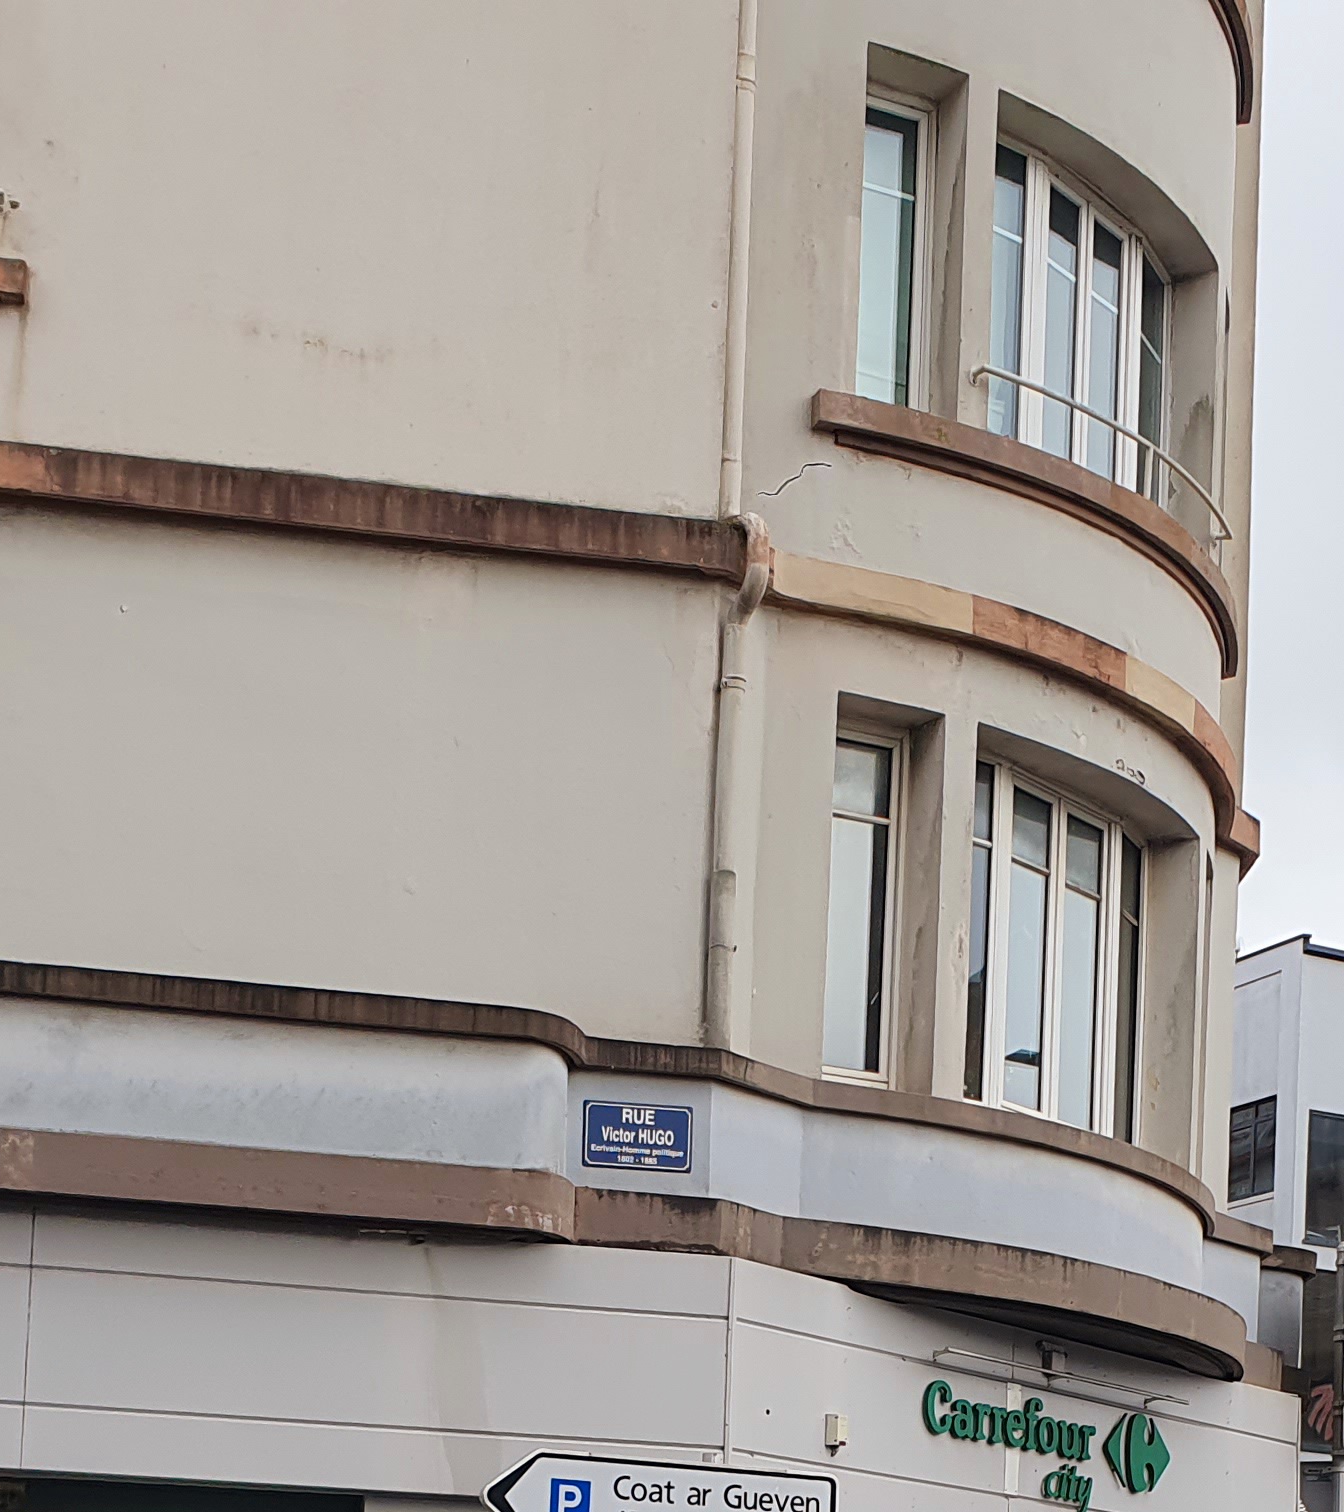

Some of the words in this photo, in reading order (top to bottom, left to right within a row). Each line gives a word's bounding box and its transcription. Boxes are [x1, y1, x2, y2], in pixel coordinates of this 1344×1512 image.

[622, 1108, 656, 1125] RUE
[601, 1125, 636, 1143] Victor
[638, 1129, 674, 1146] HUGO
[617, 1155, 634, 1164] 1802
[640, 1157, 658, 1165] 1885
[652, 1148, 684, 1158] politique
[922, 1379, 1096, 1461] Carrefour
[613, 1475, 675, 1505] Coat
[686, 1486, 711, 1506] ar
